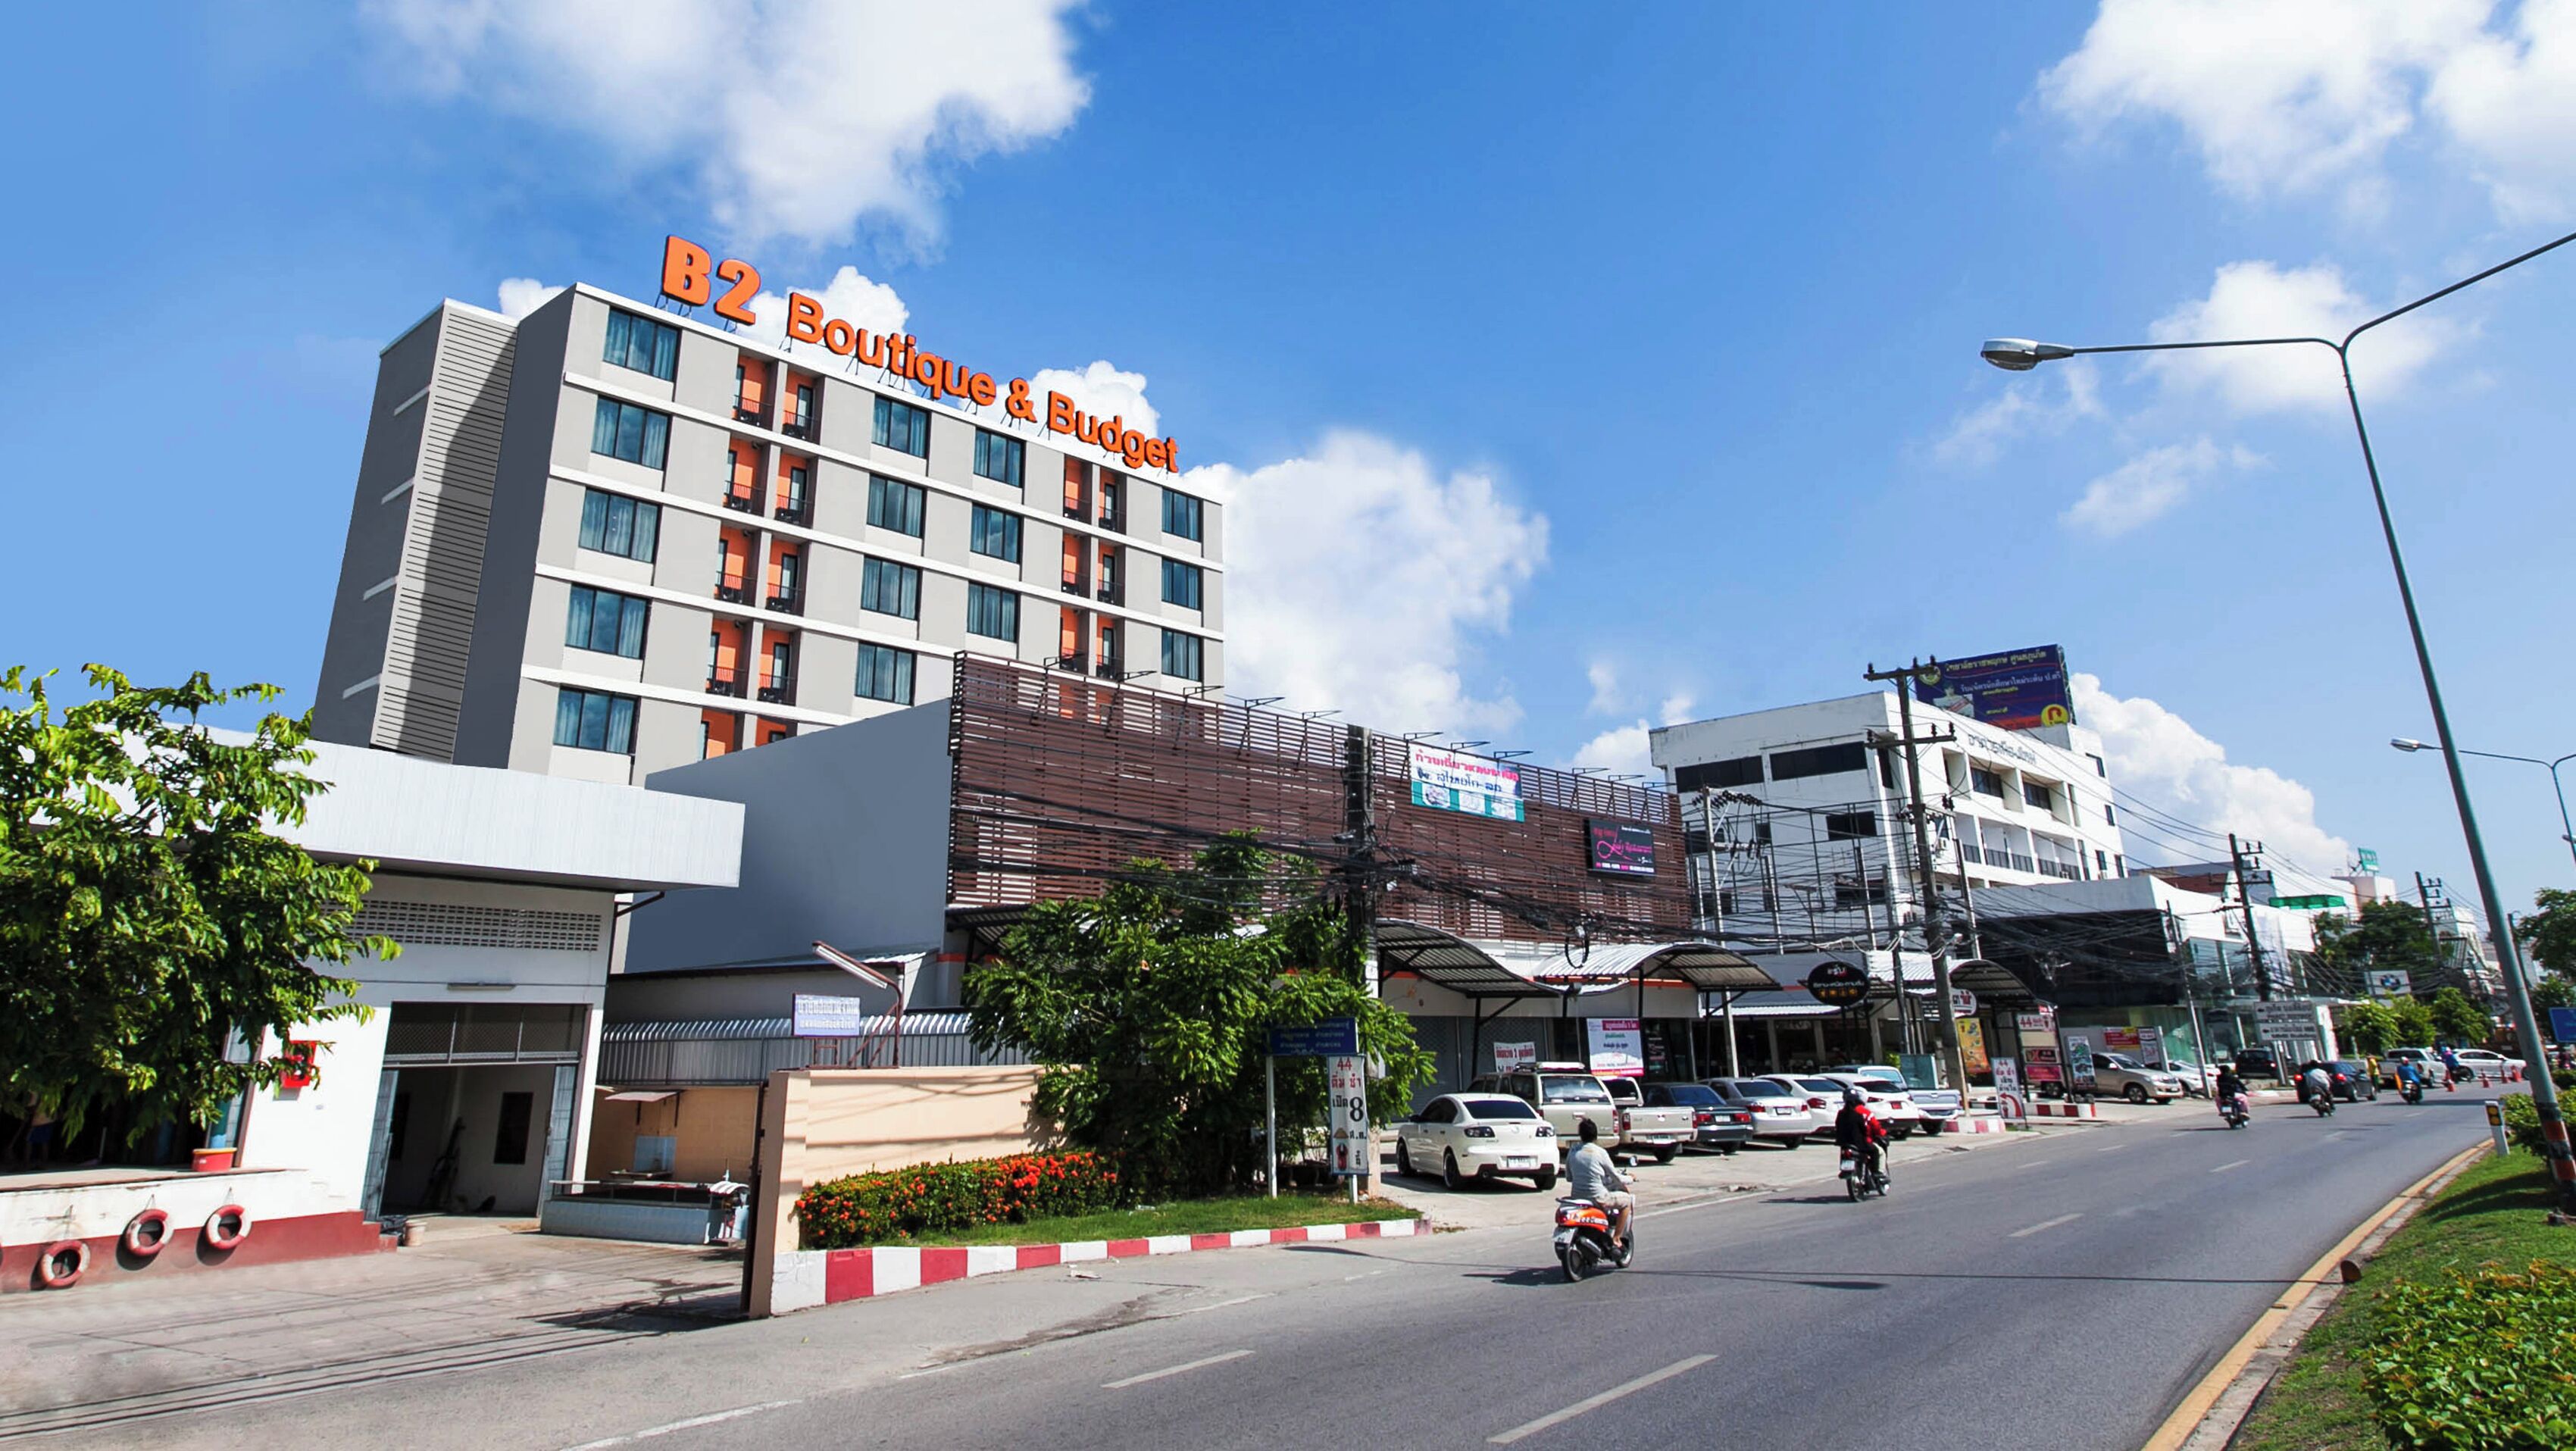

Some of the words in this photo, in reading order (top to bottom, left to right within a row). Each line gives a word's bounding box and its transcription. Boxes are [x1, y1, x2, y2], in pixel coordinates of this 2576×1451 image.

[661, 235, 761, 325] B2
[787, 292, 997, 406] Boutique
[1006, 377, 1038, 423] &
[1048, 390, 1180, 474] Budget
[2020, 1016, 2032, 1027] 44
[1337, 1057, 1352, 1071] 44
[1333, 1094, 1349, 1108] เปิด
[1349, 1096, 1364, 1121] 8
